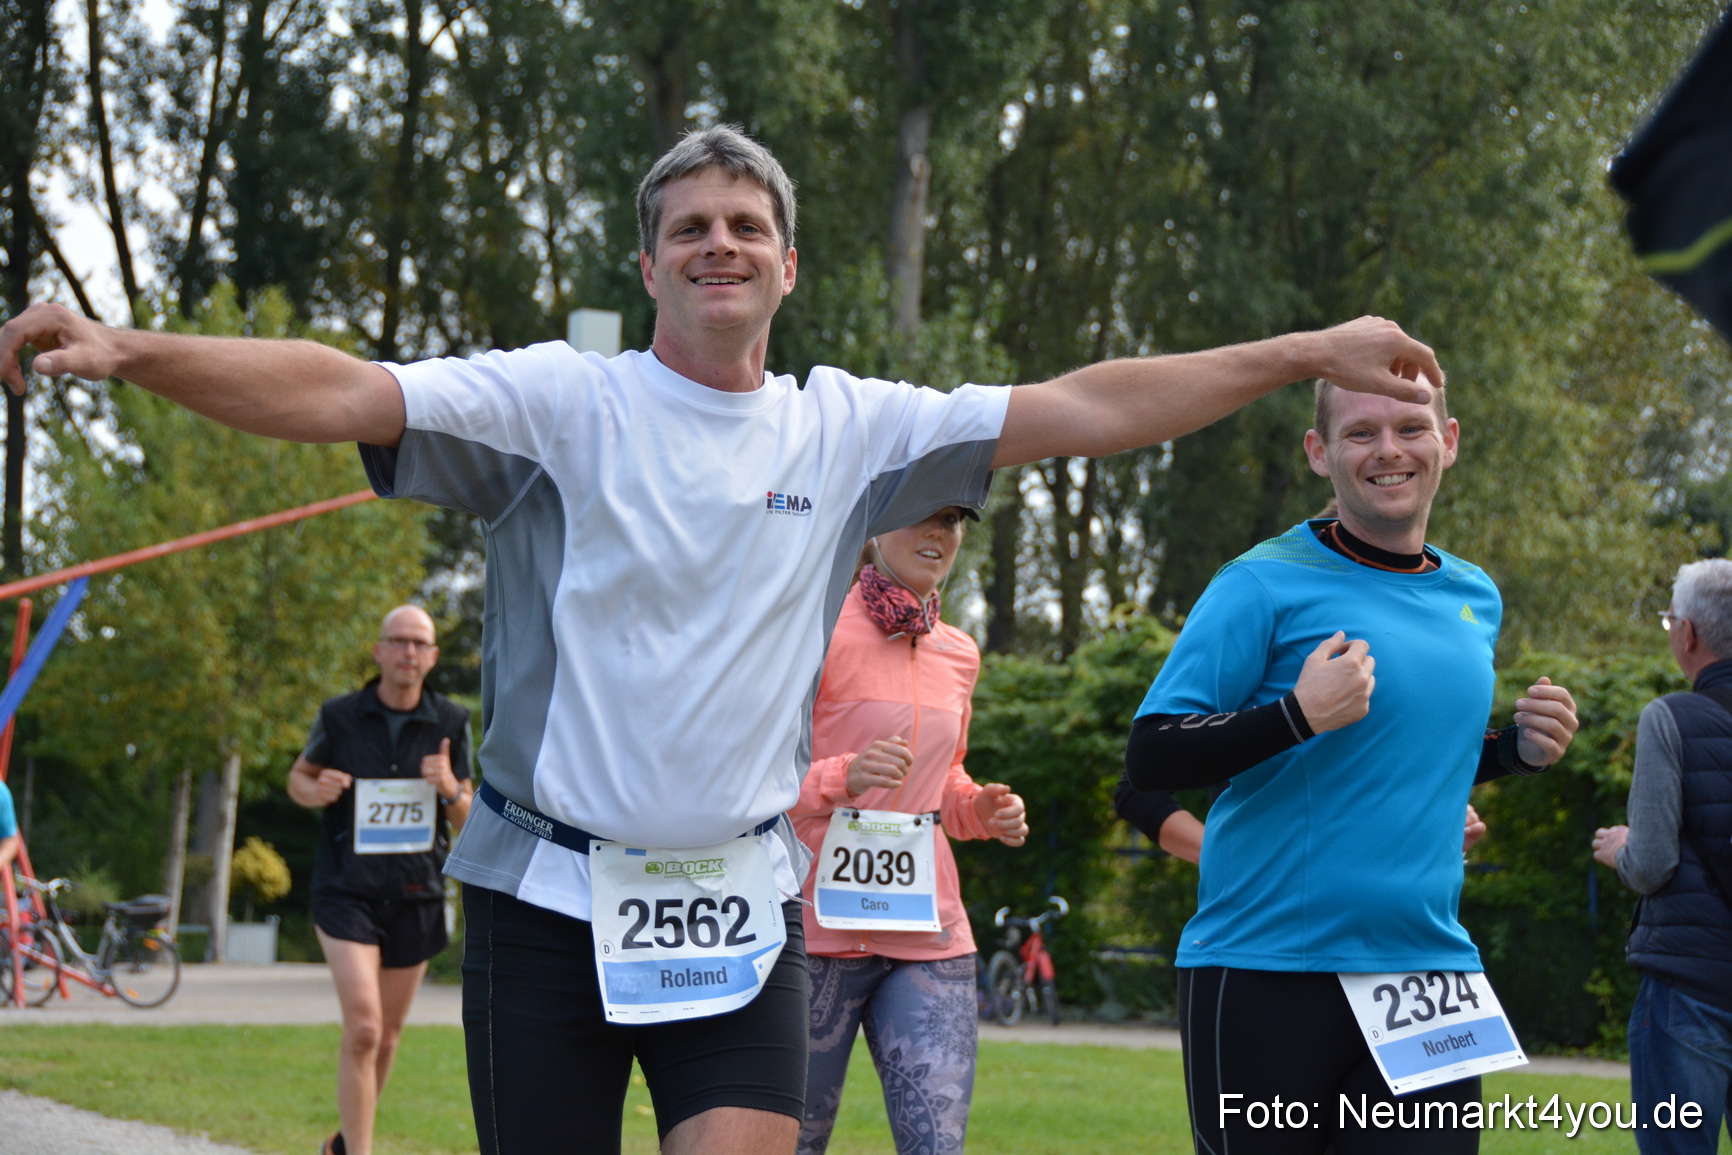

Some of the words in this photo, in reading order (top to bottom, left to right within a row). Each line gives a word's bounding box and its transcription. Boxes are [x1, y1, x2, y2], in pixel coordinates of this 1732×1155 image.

[368, 802, 423, 824] 2775
[501, 811, 553, 840] ALKOHOLFREI
[504, 799, 554, 834] ERDINGER
[860, 822, 901, 834] BOCK
[665, 858, 724, 875] BOCK
[832, 847, 915, 886] 2039
[861, 898, 889, 911] Caro
[618, 895, 757, 950] 2562
[660, 966, 728, 988] Roland
[1373, 970, 1479, 1031] 2324
[1422, 1030, 1477, 1057] Norbert
